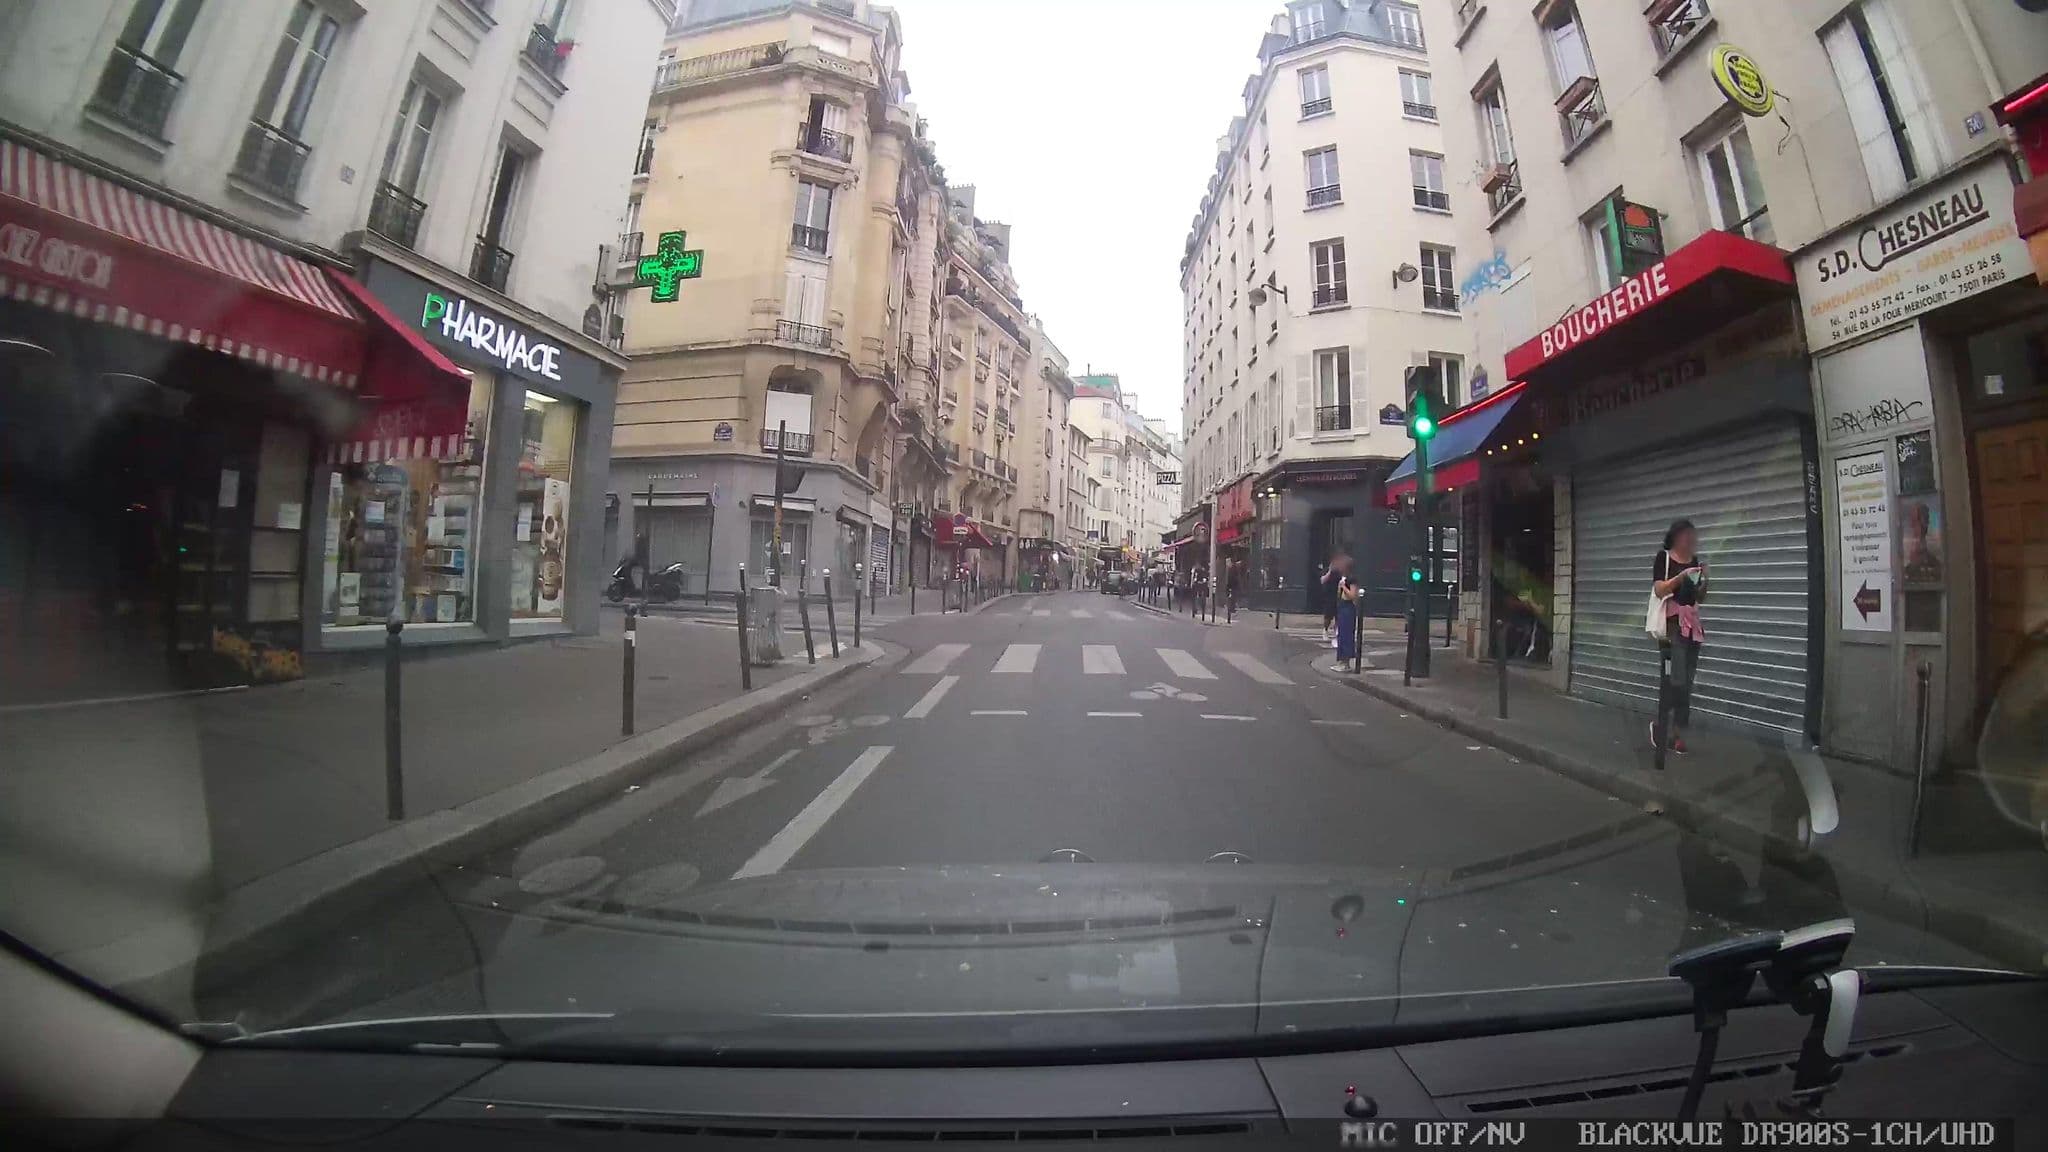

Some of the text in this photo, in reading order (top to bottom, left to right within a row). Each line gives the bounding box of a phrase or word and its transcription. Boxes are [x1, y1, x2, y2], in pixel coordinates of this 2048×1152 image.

[1818, 184, 1985, 283] S.D. CHESNEAU
[1982, 268, 2006, 286] PARIS
[1541, 262, 1671, 359] BOUCHERIE
[1872, 301, 1881, 311] 55
[1939, 273, 1948, 285] 01
[1951, 269, 1961, 280] 43
[1964, 264, 1975, 276] 55
[422, 292, 562, 381] PHARMACIE
